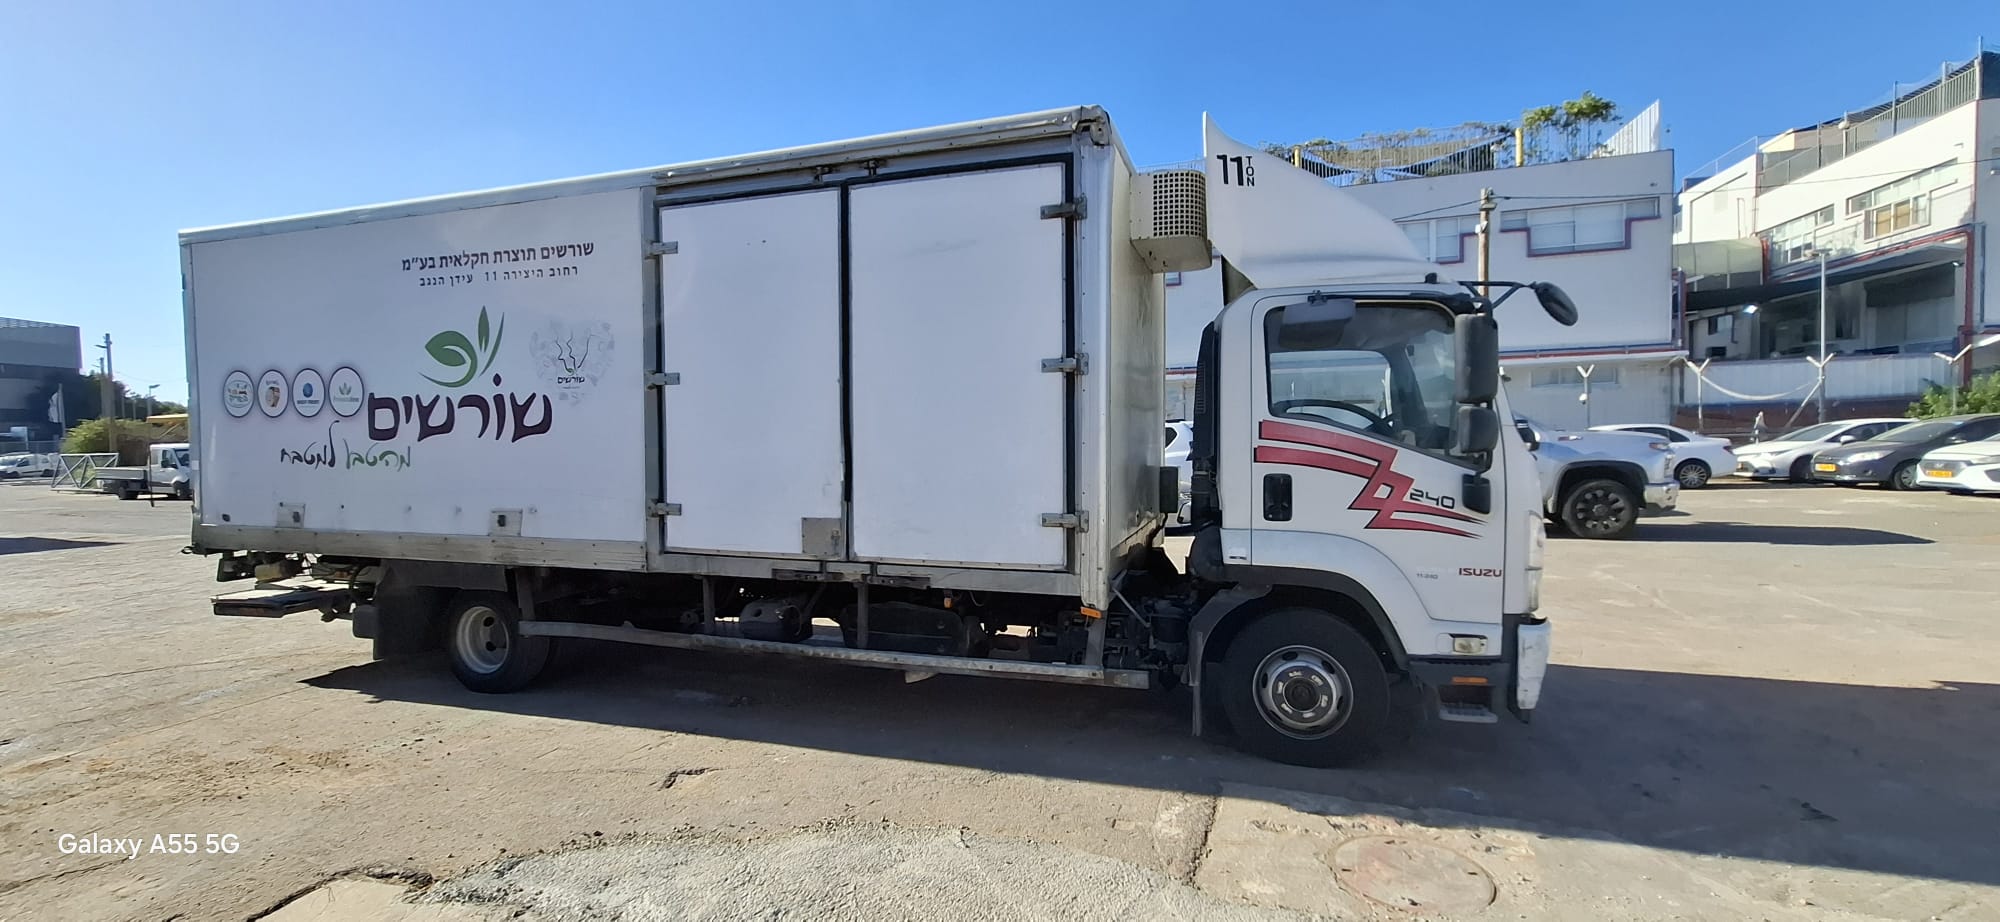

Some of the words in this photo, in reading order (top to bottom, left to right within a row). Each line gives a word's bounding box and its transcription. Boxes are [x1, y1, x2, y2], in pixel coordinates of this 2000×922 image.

[1216, 154, 1244, 187] 11
[1245, 155, 1255, 187] TON
[493, 247, 536, 264] תוצרת
[541, 242, 594, 259] שורשים
[439, 250, 489, 270] חקלאית
[449, 273, 473, 287] עידן
[503, 268, 544, 281] היצירה
[549, 266, 578, 277] רחוב
[1409, 487, 1456, 510] 240
[1458, 567, 1502, 578] ISUZU
